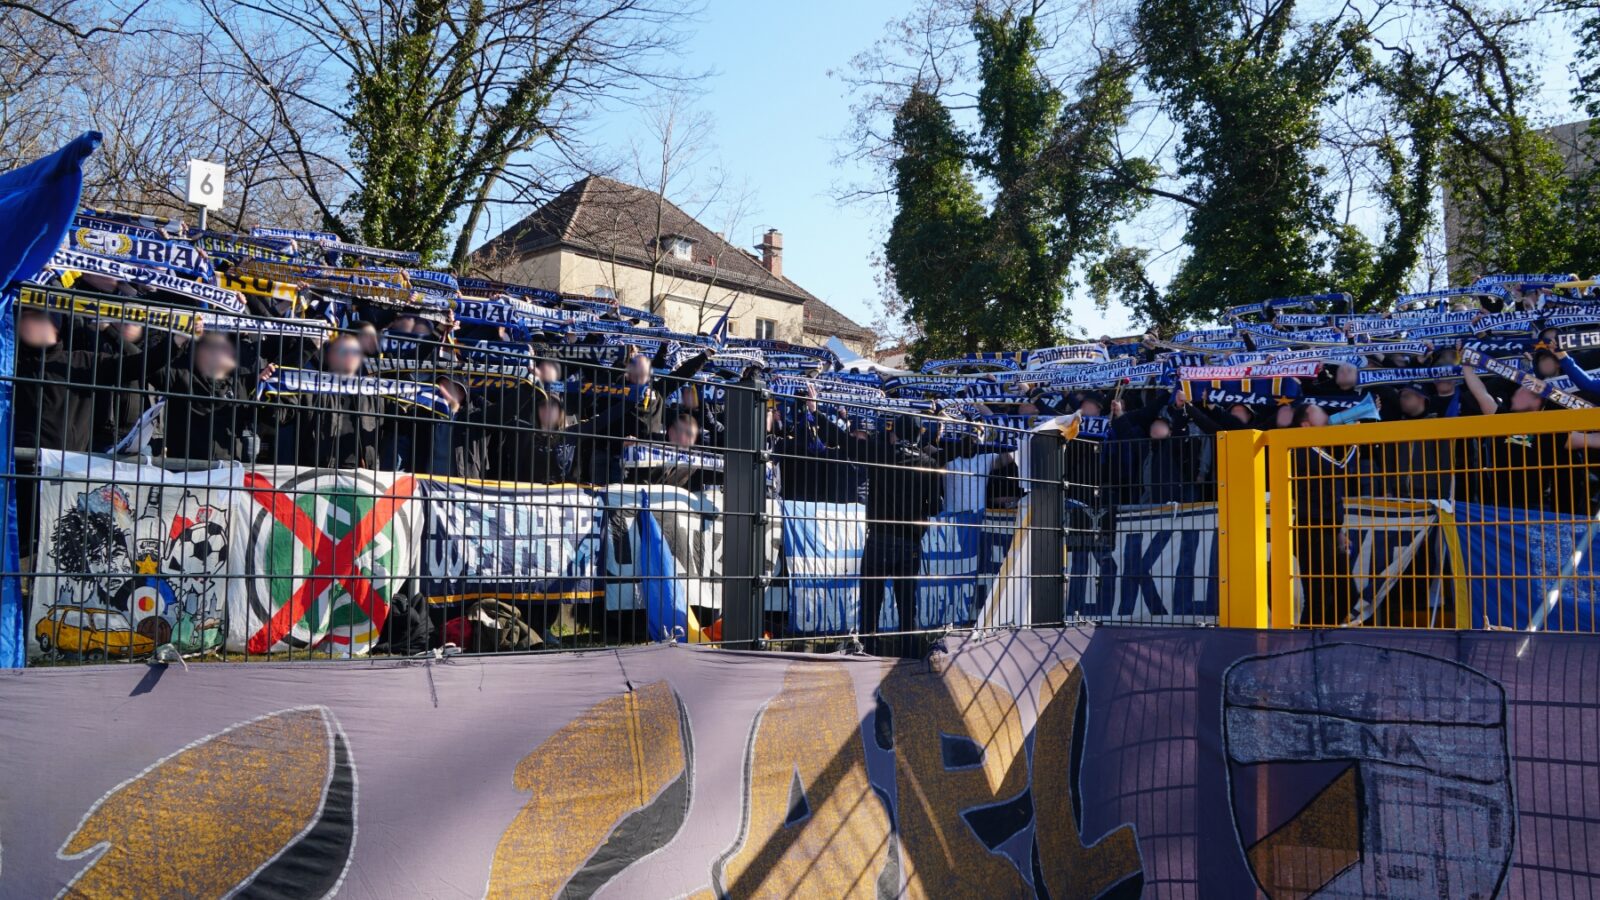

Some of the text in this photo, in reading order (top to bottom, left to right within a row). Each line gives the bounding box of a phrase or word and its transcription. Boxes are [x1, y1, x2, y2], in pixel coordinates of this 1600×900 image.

[200, 172, 214, 195] 6
[1559, 333, 1577, 349] FC
[284, 370, 422, 399] UNBEUGSAM
[1208, 389, 1268, 406] Horda
[1290, 716, 1428, 764] JENA
